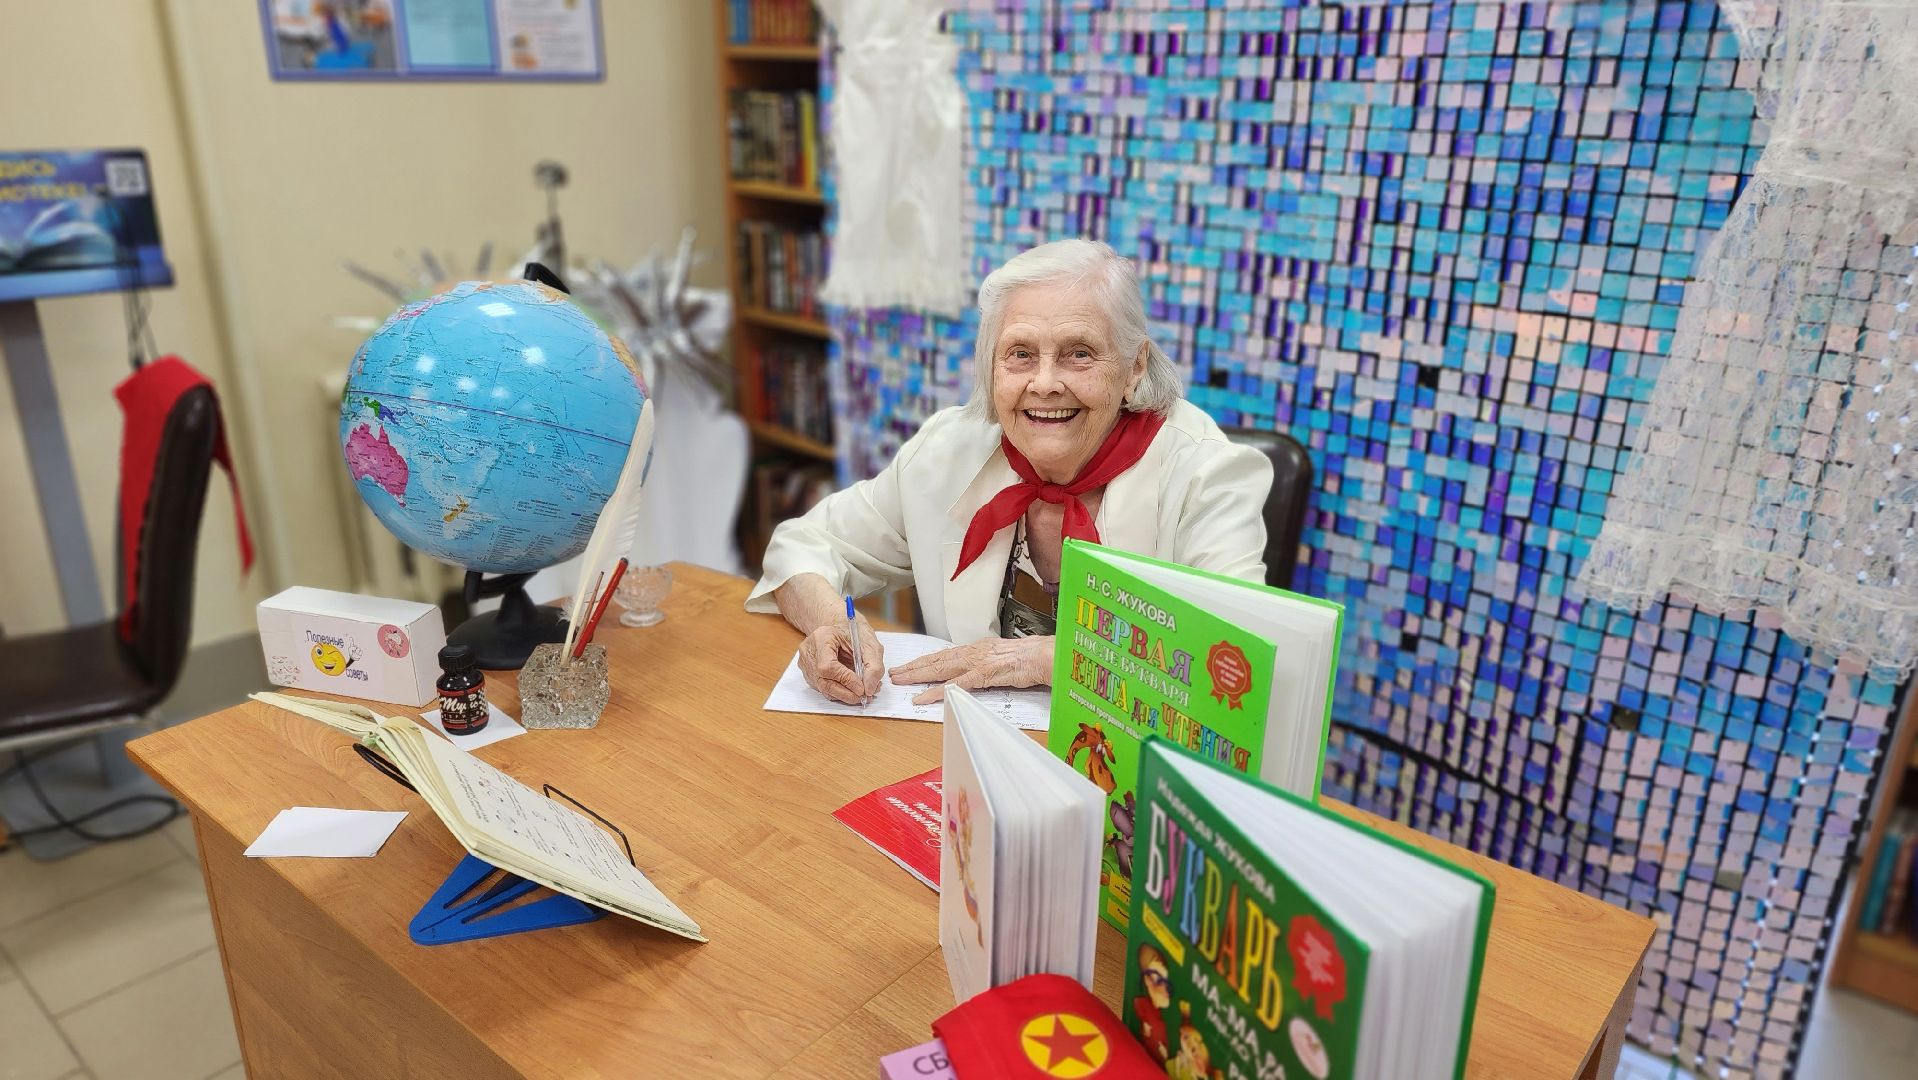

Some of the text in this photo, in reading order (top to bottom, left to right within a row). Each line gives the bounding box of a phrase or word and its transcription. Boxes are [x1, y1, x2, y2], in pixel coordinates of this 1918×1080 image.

[305, 630, 345, 649] Полезные
[1086, 572, 1177, 632] Н. С. ЖУКОВА
[345, 668, 369, 682] советы
[1074, 630, 1118, 667] ПОСЛЕ
[1121, 652, 1190, 708] БУКВАРЯ
[1075, 595, 1195, 687] ПЕРВАЯ
[1070, 649, 1129, 713] КНИГА
[1161, 701, 1252, 773] ЧТЕНИЯ
[1213, 831, 1277, 905] ЖУКОВА
[1145, 800, 1283, 1031] БУКВАРЬ
